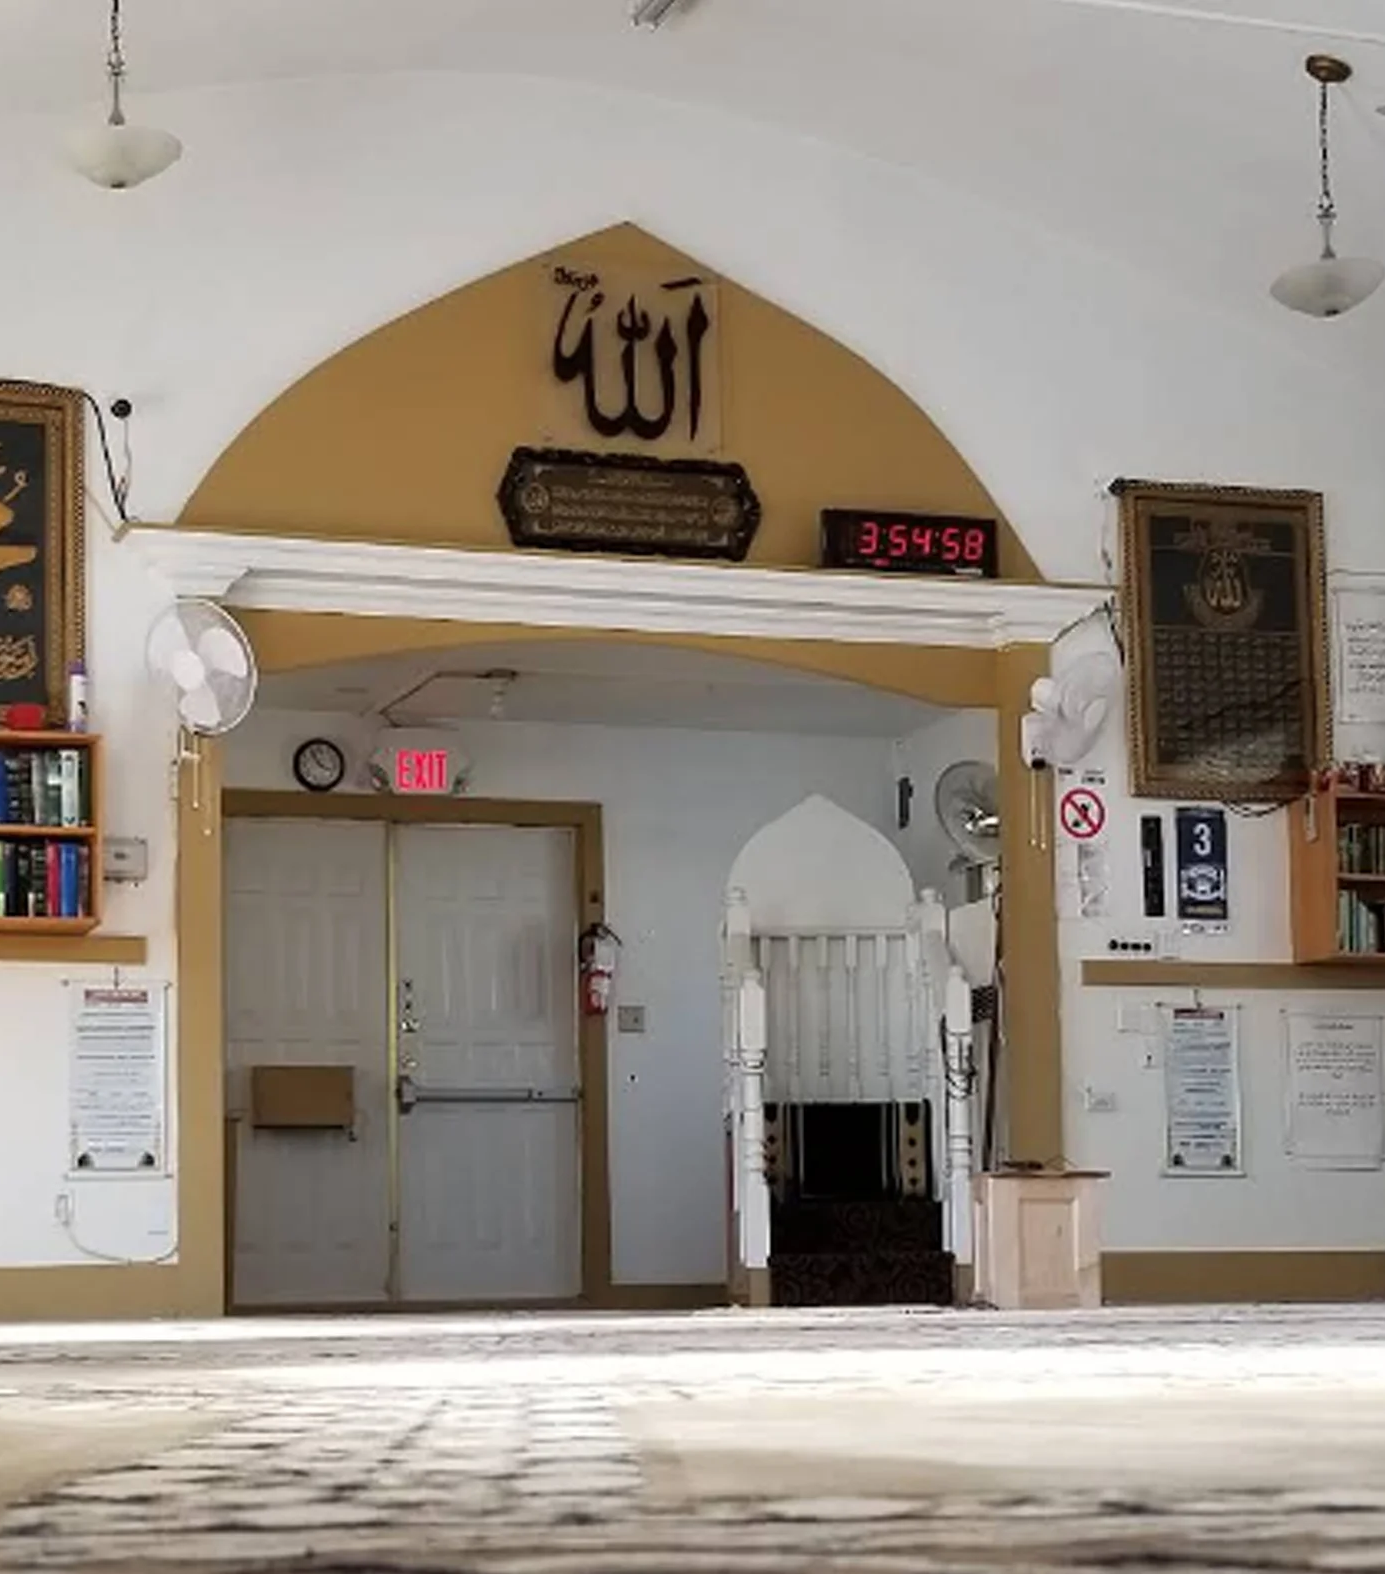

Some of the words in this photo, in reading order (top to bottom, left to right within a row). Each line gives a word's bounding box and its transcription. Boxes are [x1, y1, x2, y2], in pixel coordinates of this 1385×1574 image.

[858, 521, 985, 561] 3:54:58
[396, 749, 447, 791] EXIT
[1193, 822, 1212, 856] 3
